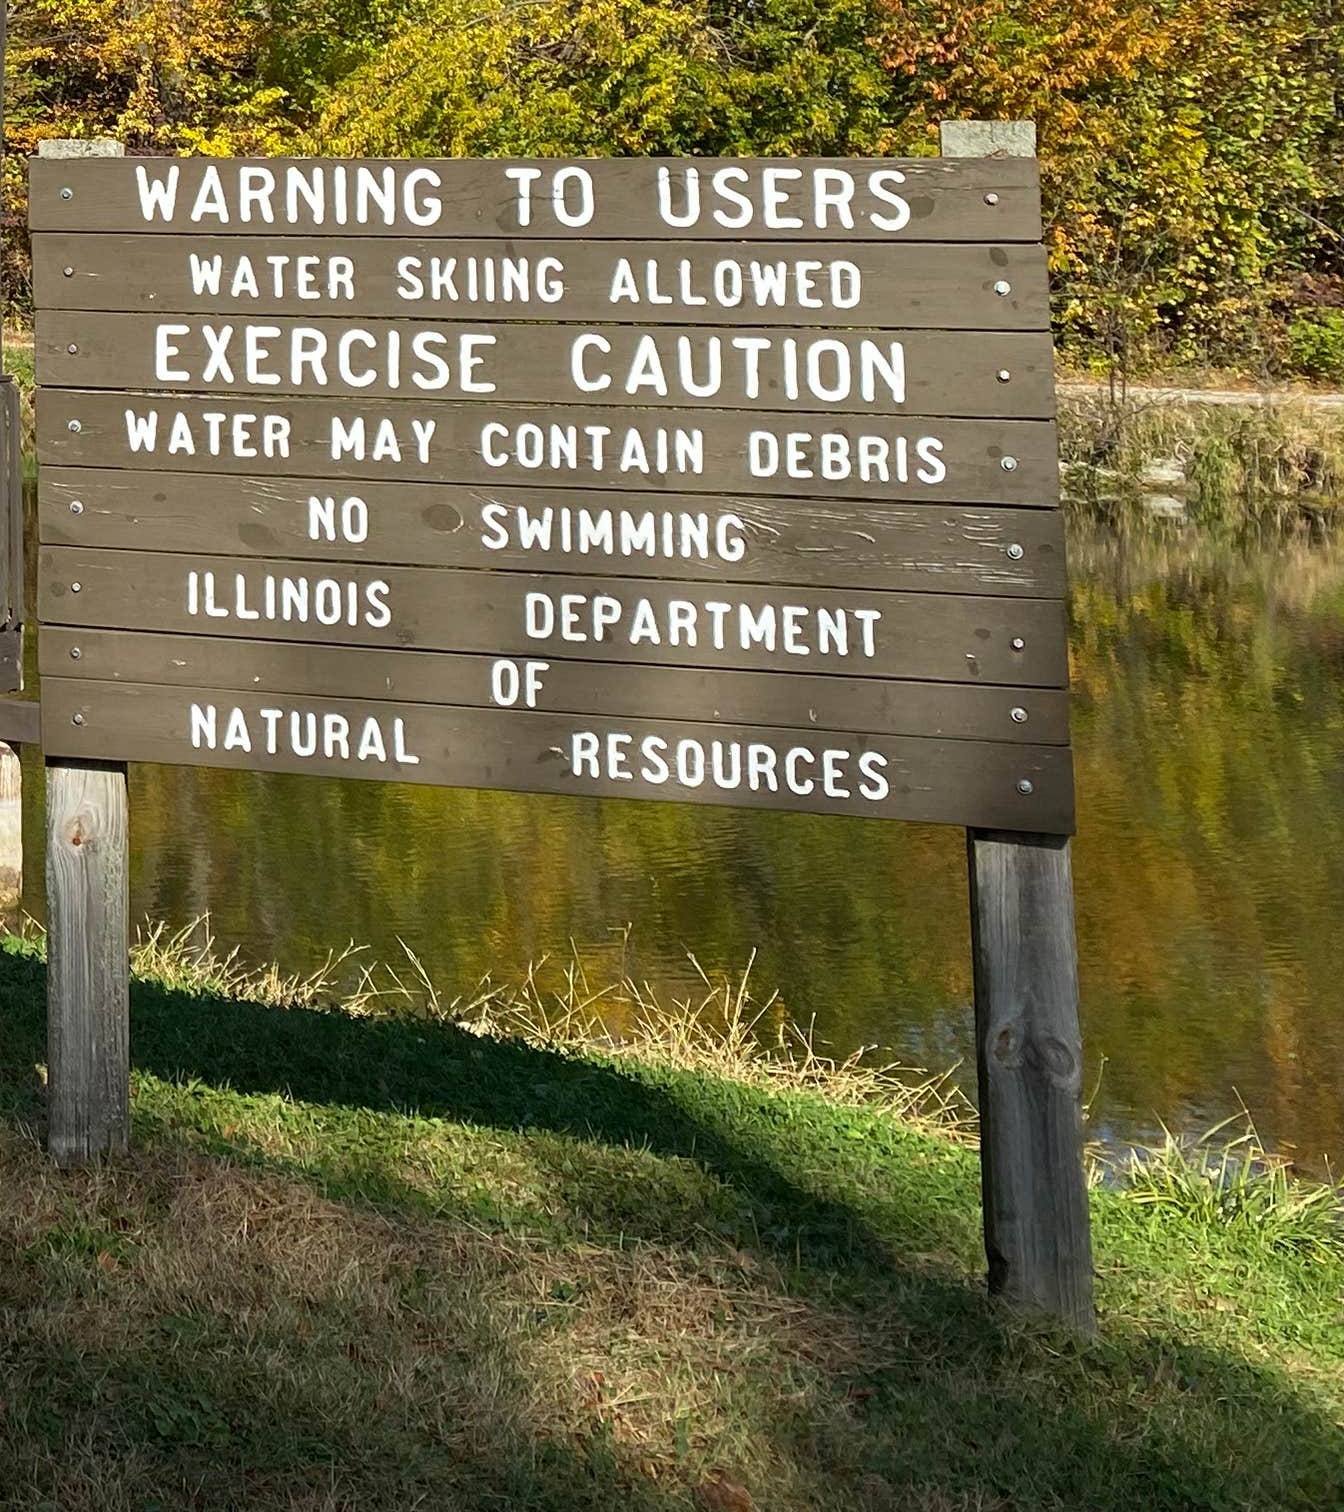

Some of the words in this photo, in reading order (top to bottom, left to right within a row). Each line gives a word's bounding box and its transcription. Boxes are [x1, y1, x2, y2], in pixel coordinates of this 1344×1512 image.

[135, 165, 442, 227] WARNING
[505, 166, 595, 228] TO
[657, 166, 911, 232] USERS
[189, 253, 355, 300] WATER
[397, 256, 564, 303] SKIING
[609, 258, 861, 309] ALLOWED
[155, 324, 497, 393] EXERCISE
[571, 333, 906, 404] CAUTION
[124, 409, 291, 458] WATER
[330, 416, 436, 464] MAY
[480, 422, 703, 474] CONTAIN
[748, 430, 946, 484] DEBRIS
[308, 496, 368, 543] NO
[481, 504, 746, 562] SWIMMING
[187, 571, 391, 628] ILLINOIS
[525, 592, 882, 657] DEPARTMENT
[491, 659, 550, 708] OF
[190, 703, 420, 764] NATURAL
[572, 731, 889, 801] RESOURCES
